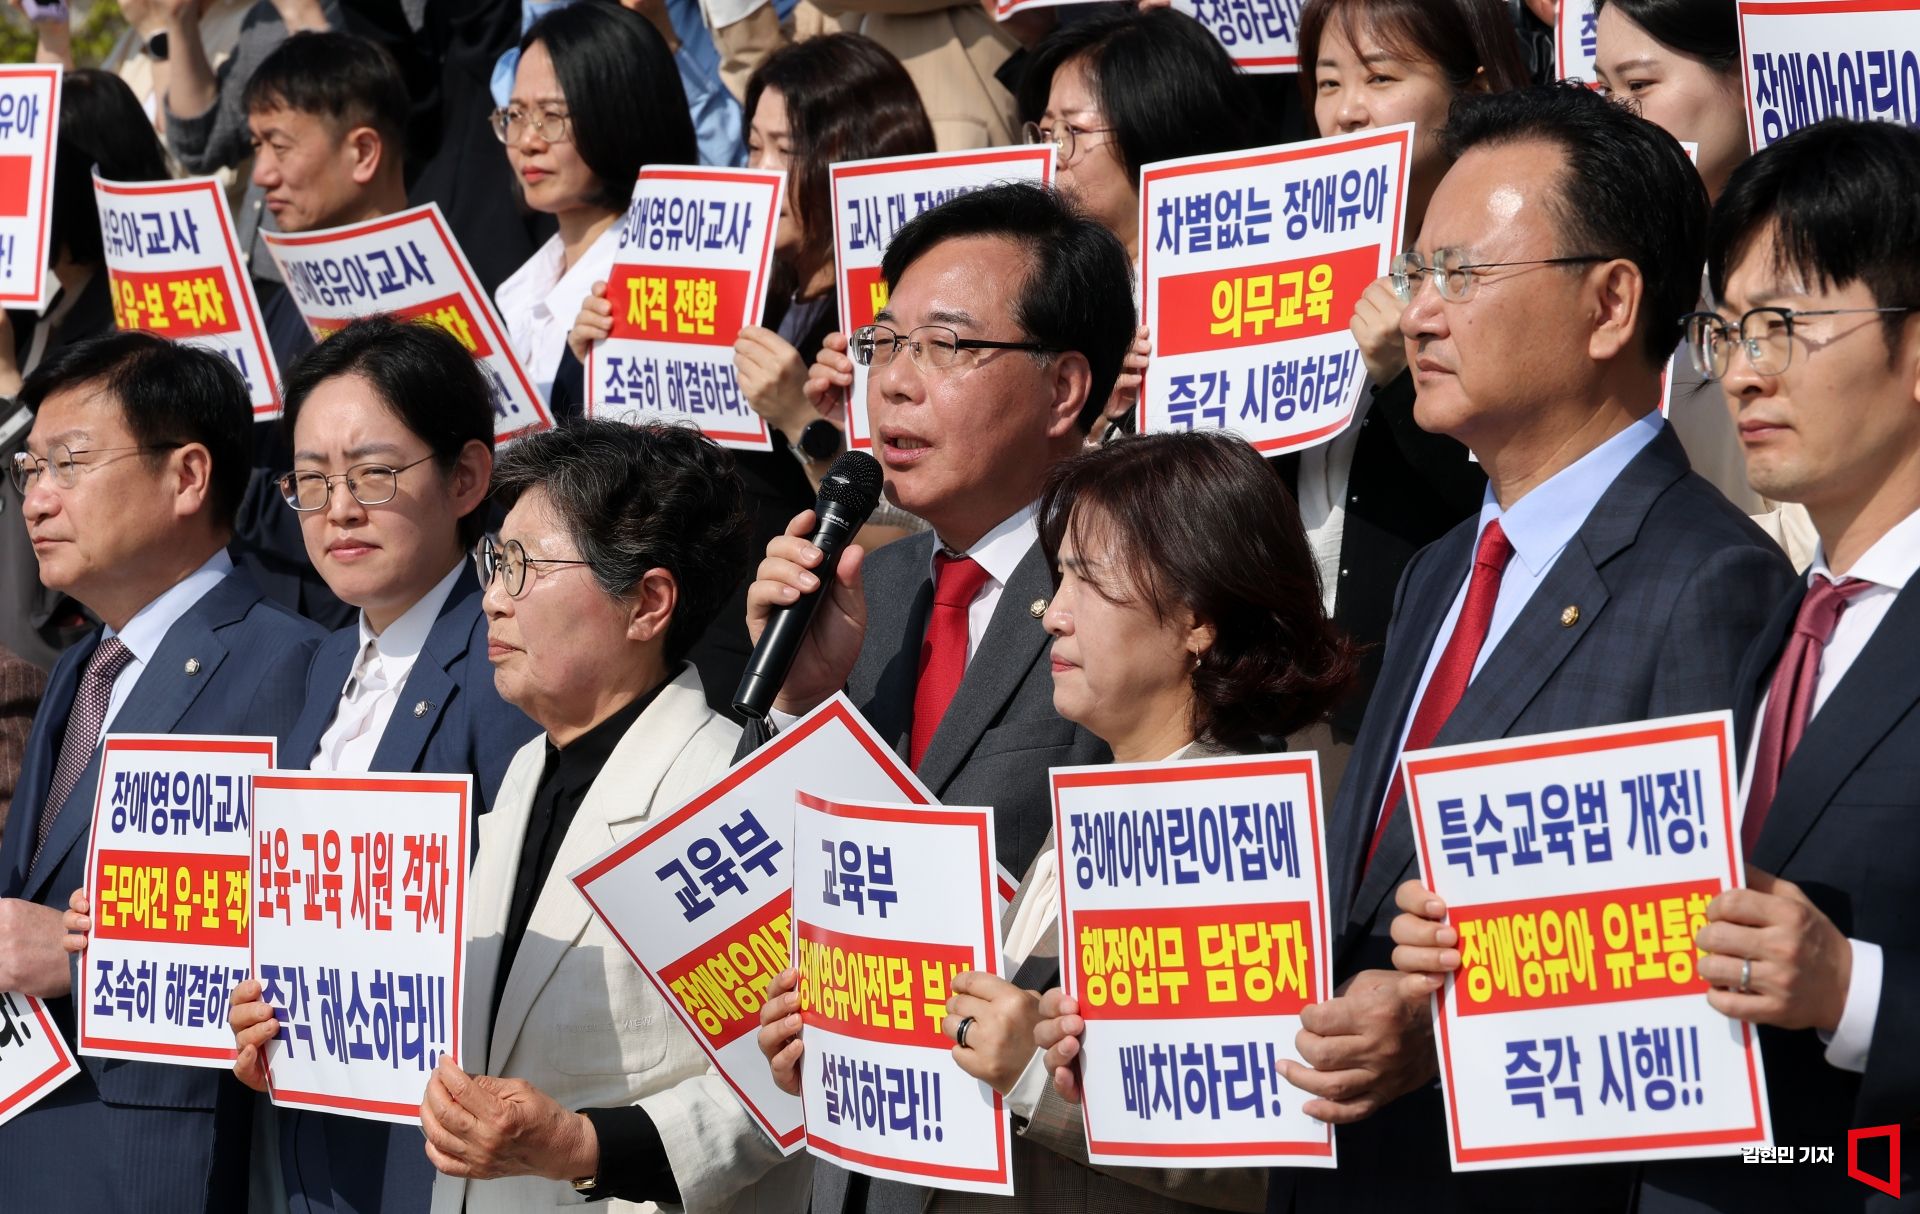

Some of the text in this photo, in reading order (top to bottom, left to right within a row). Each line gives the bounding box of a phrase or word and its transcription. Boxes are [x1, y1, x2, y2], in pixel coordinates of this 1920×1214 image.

[104, 208, 200, 257] 유아교사
[848, 196, 881, 250] 교사
[1156, 165, 1388, 255] 차별없는 장애유아
[123, 280, 171, 329] 유-보
[168, 277, 227, 329] 격차
[281, 242, 435, 306] 영유아교사
[626, 277, 718, 335] 자격 전환
[1210, 264, 1334, 338] 의무교육
[605, 356, 662, 411] 조속히
[1168, 350, 1360, 430] 즉각 시행하라!
[1070, 801, 1301, 890] 장애아어린이집에
[1437, 769, 1709, 878] 특수교육법 개정!
[101, 864, 168, 930] 근무여건
[173, 866, 221, 931] 유-보
[258, 828, 449, 934] 보육-교육 지원 격차
[655, 808, 784, 923] 교육부
[822, 839, 898, 919] 교육부
[93, 959, 157, 1025] 조속히
[798, 937, 915, 1031] 장애영유아전담
[1081, 919, 1309, 1007] 행정업무 담당자
[1458, 907, 1597, 1003] 장애영유아
[260, 964, 446, 1072] 즉각 해소하라!!
[821, 1052, 944, 1143] 설치하라!!
[1118, 1041, 1282, 1121] 배치하라!
[1504, 1026, 1705, 1119] 즉각 시행!!
